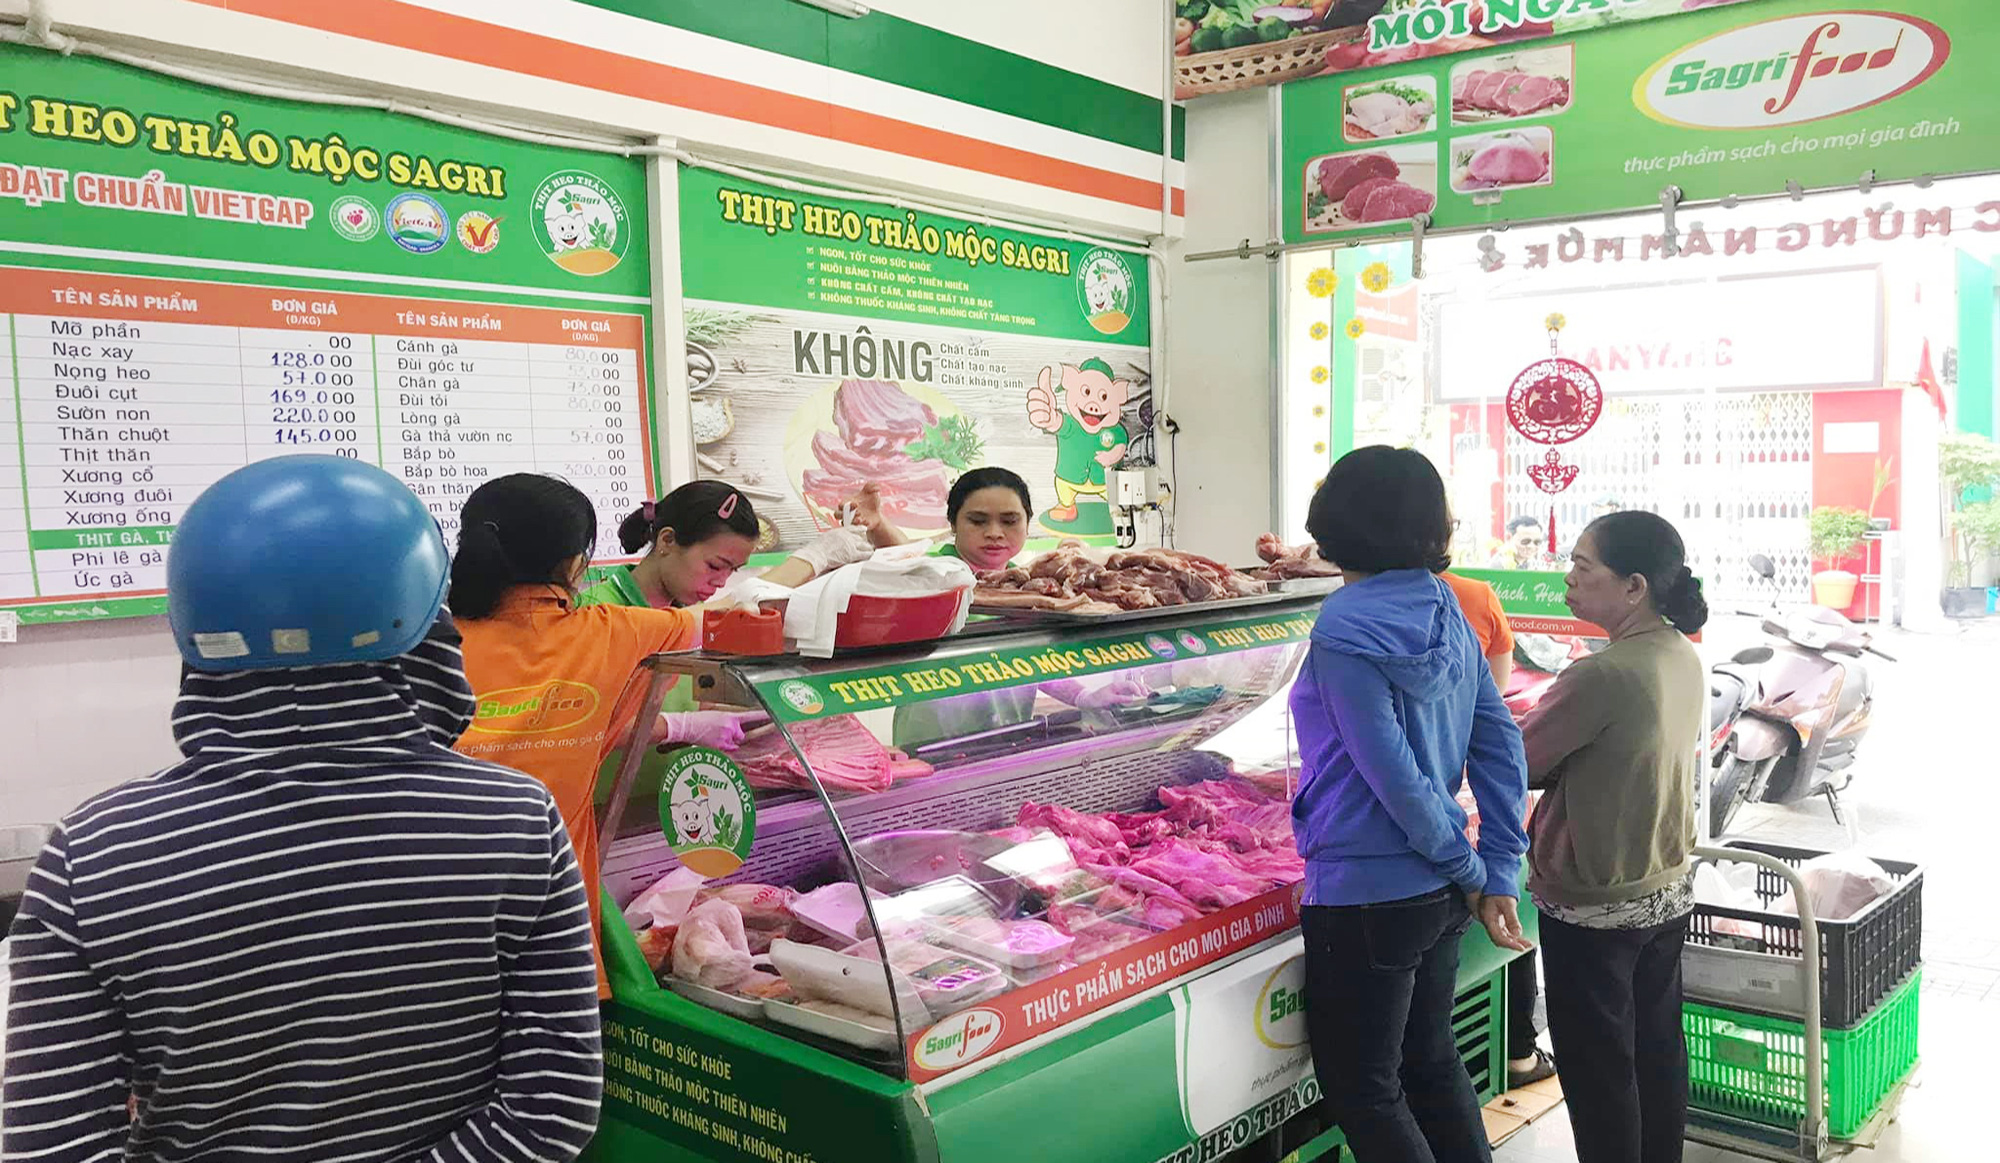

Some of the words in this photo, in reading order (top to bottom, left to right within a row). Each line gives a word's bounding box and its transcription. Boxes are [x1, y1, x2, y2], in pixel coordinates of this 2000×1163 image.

[1664, 22, 1903, 114] Sagrifood
[29, 99, 137, 145] HEO
[145, 114, 279, 165] THẢO
[289, 136, 379, 182] MỘC
[388, 154, 504, 197] SAGRI
[1624, 156, 1664, 175] thực
[1667, 147, 1727, 172] phẩm
[1730, 140, 1776, 163] sạch
[1781, 136, 1818, 154] cho
[1823, 128, 1866, 150] mọi
[1869, 125, 1904, 147] gia
[1909, 117, 1960, 139] đình
[551, 175, 574, 189] HEO
[576, 175, 608, 197] THẢO
[0, 166, 64, 203] ĐẠT
[77, 172, 184, 212] CHUẨN
[193, 188, 310, 227] VIETGAP
[719, 190, 795, 234] THỊT
[803, 204, 862, 240] HEO
[866, 212, 940, 254] THẢO
[945, 226, 997, 266] MỘC
[1002, 240, 1070, 275] SAGRI
[869, 255, 888, 266] CHO
[52, 287, 93, 306] TÊN
[98, 288, 141, 309] SẢN
[144, 291, 198, 312] PHẨM
[271, 298, 307, 315] ĐƠN
[310, 299, 339, 317] GIÁ
[51, 320, 83, 337] Mỡ
[92, 322, 141, 340] phần
[396, 311, 426, 327] TÊN
[430, 312, 459, 328] SẢN
[462, 313, 502, 331] PHẨM
[562, 317, 588, 331] ĐƠN
[590, 319, 612, 333] GIÁ
[52, 342, 93, 360] Nạc
[101, 346, 134, 361] xay
[396, 339, 435, 353] Cánh
[441, 342, 458, 356] gà
[794, 325, 933, 383] KHÔNG
[940, 343, 964, 355] Chất
[968, 345, 990, 357] cấm
[54, 363, 107, 382] Nọng
[116, 364, 151, 381] heo
[397, 357, 423, 371] Đùi
[428, 359, 455, 374] góc
[461, 360, 475, 372] tư
[940, 358, 965, 371] Chất
[968, 360, 985, 374] tạo
[989, 364, 1007, 375] nạc
[398, 374, 437, 389] Chân
[443, 377, 461, 391] gà
[941, 373, 966, 385] Chất
[969, 375, 1000, 390] kháng
[1003, 377, 1024, 389] sinh
[55, 384, 100, 400] Đuôi
[108, 386, 138, 402] cụt
[399, 392, 424, 406] Đùi
[430, 394, 449, 408] tỏi
[57, 404, 107, 421] Sườn
[115, 408, 151, 421] non
[401, 411, 438, 427] Lòng
[443, 413, 461, 428] gà
[58, 426, 109, 442] Thăn
[118, 427, 170, 444] chuột
[401, 428, 422, 442] Gà
[428, 428, 452, 442] thả
[458, 429, 491, 443] vườn
[59, 447, 100, 464] Thịt
[107, 448, 152, 462] thăn
[403, 446, 432, 462] Bắp
[438, 447, 456, 460] bò
[62, 468, 123, 486] Xương
[131, 465, 154, 483] cổ
[404, 464, 433, 479] Bắp
[440, 464, 457, 477] bò
[463, 465, 488, 477] hoa
[64, 489, 125, 506] Xương
[134, 488, 174, 504] đuôi
[66, 510, 127, 527] Xương
[135, 507, 172, 525] ống
[75, 532, 114, 548] THỊT
[72, 551, 108, 568] Phi
[113, 549, 130, 565] lê
[139, 550, 163, 569] gà
[74, 569, 102, 589] Ức
[110, 571, 134, 590] gà
[1207, 627, 1255, 649] THỊT
[1250, 620, 1290, 642] HEO
[829, 675, 903, 704] THỊT
[902, 667, 963, 693] HEO
[960, 652, 1034, 684] THẢO
[1030, 648, 1087, 676] MỘC
[1082, 641, 1153, 667] SAGRI
[662, 763, 680, 793] THỊT
[680, 751, 703, 767] HEO
[705, 752, 737, 780] THẢO
[735, 780, 752, 813] MỘC
[700, 774, 729, 791] Sagri
[1022, 988, 1071, 1028] THỰC
[1075, 961, 1124, 1006] PHẨM
[1126, 955, 1168, 986] SẠCH
[1169, 937, 1199, 968] CHO
[1201, 929, 1228, 955] MỌI
[1230, 916, 1252, 942] GIA
[1254, 902, 1286, 932] ĐÌNH
[926, 1014, 993, 1059] Sagrifood
[629, 1026, 649, 1050] TỐT
[652, 1037, 674, 1059] CHO
[676, 1044, 699, 1068] SỨC
[701, 1053, 732, 1081] KHỎE
[654, 1067, 683, 1094] THẢO
[685, 1080, 710, 1105] MỘC
[712, 1089, 748, 1119] THIÊN
[750, 1104, 787, 1135] NHIÊN
[635, 1090, 670, 1120] THUỐC
[672, 1105, 710, 1136] KHÁNG
[711, 1122, 742, 1152] SINH,
[1199, 1115, 1250, 1163] HEO
